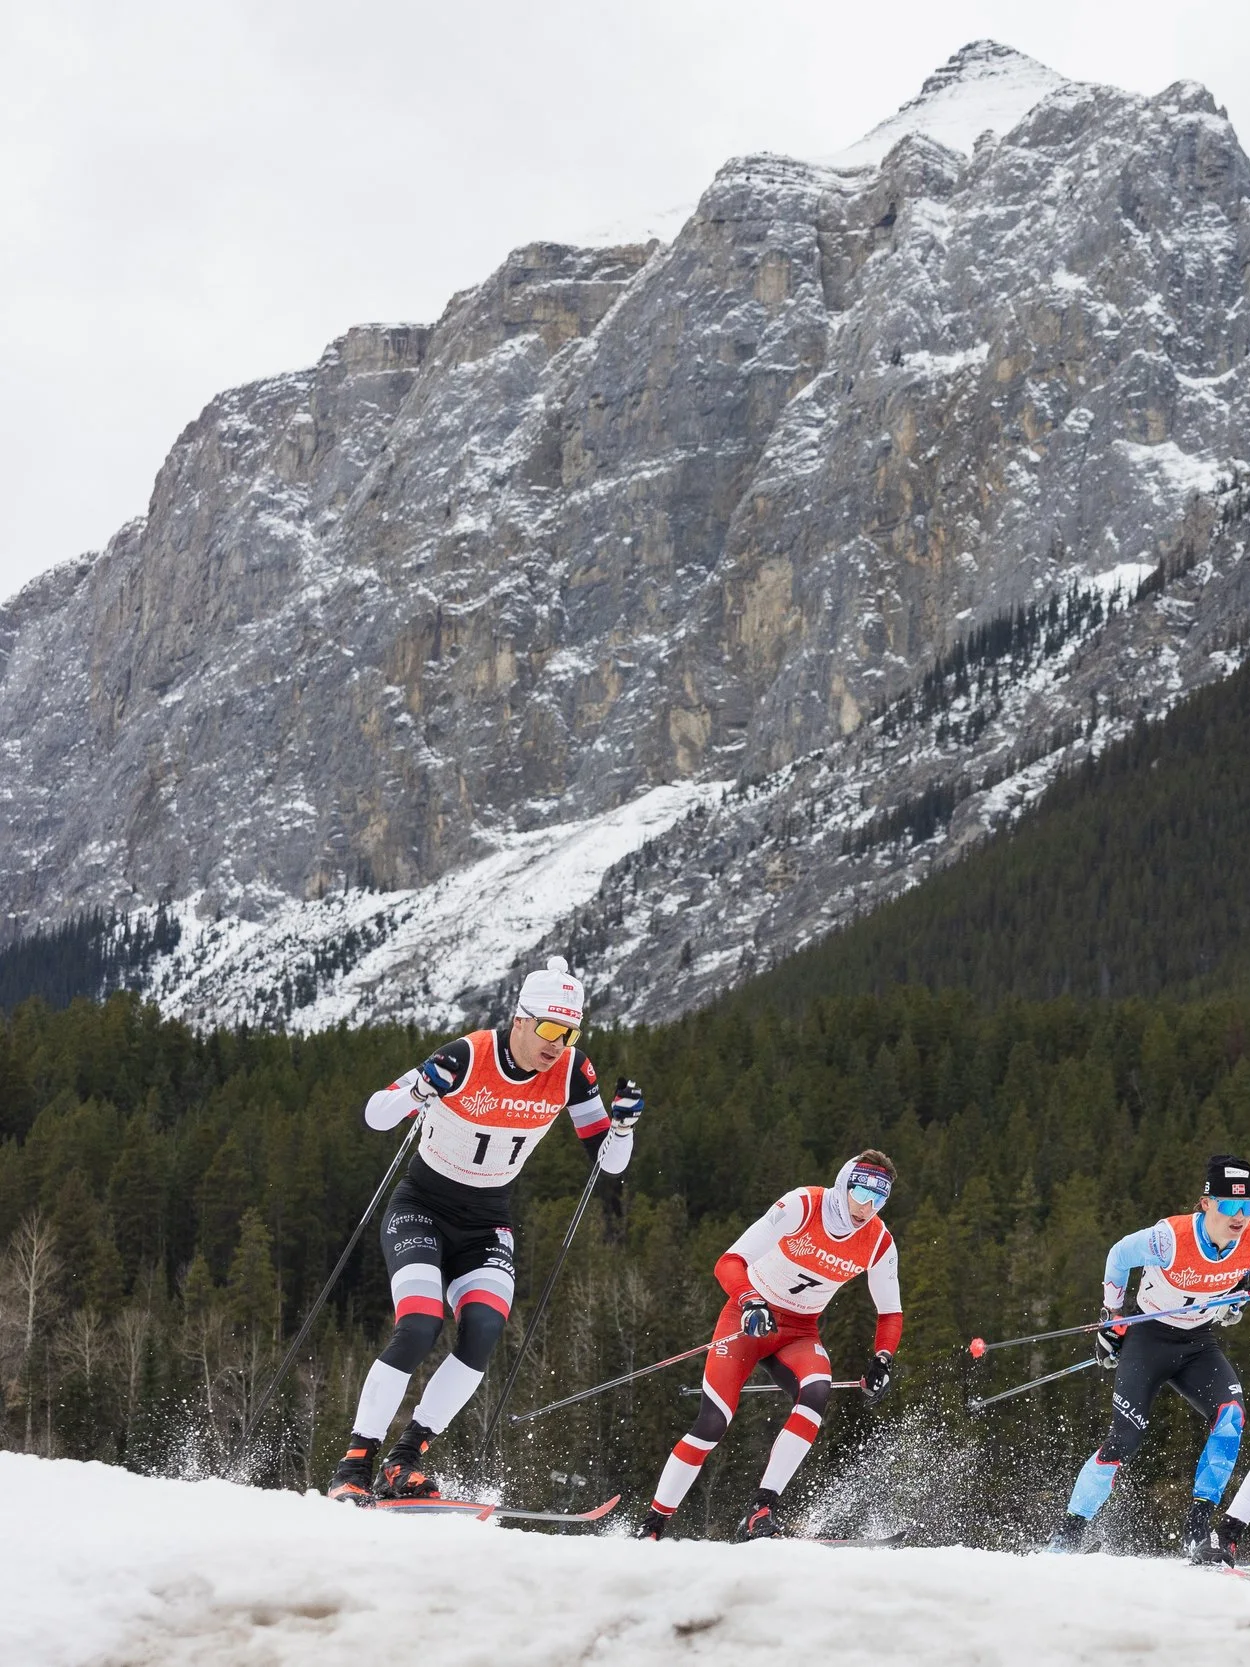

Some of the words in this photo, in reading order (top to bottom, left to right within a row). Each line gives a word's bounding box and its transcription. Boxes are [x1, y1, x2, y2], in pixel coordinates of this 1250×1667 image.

[472, 1132, 527, 1166] 11
[394, 1236, 437, 1251] excel
[788, 1273, 823, 1295] 7
[1129, 1407, 1148, 1430] LAW
